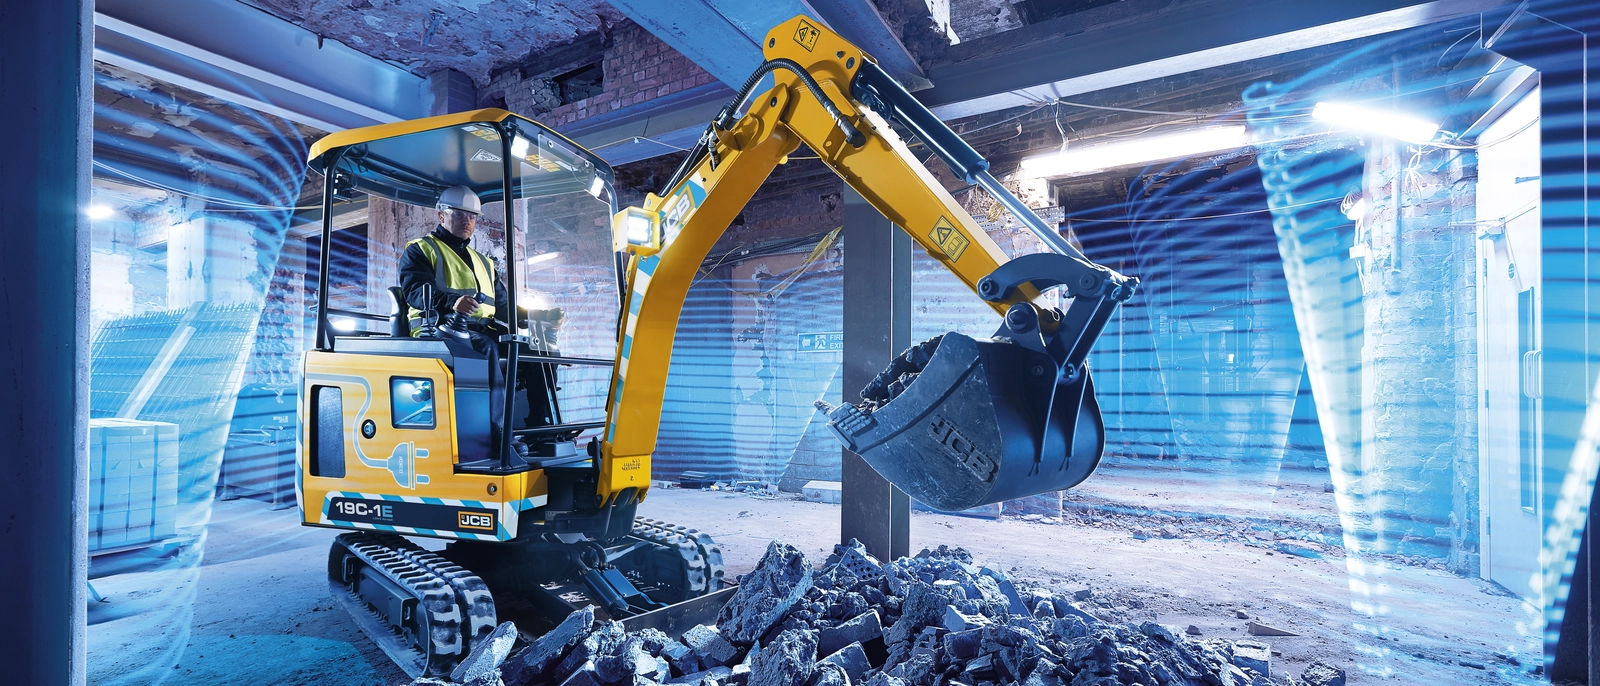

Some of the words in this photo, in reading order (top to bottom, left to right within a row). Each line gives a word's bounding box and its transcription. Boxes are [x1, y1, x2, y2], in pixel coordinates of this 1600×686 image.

[660, 193, 691, 243] JCB
[927, 413, 999, 483] JCB
[335, 501, 393, 518] 19C-1E
[461, 515, 490, 526] JCB
